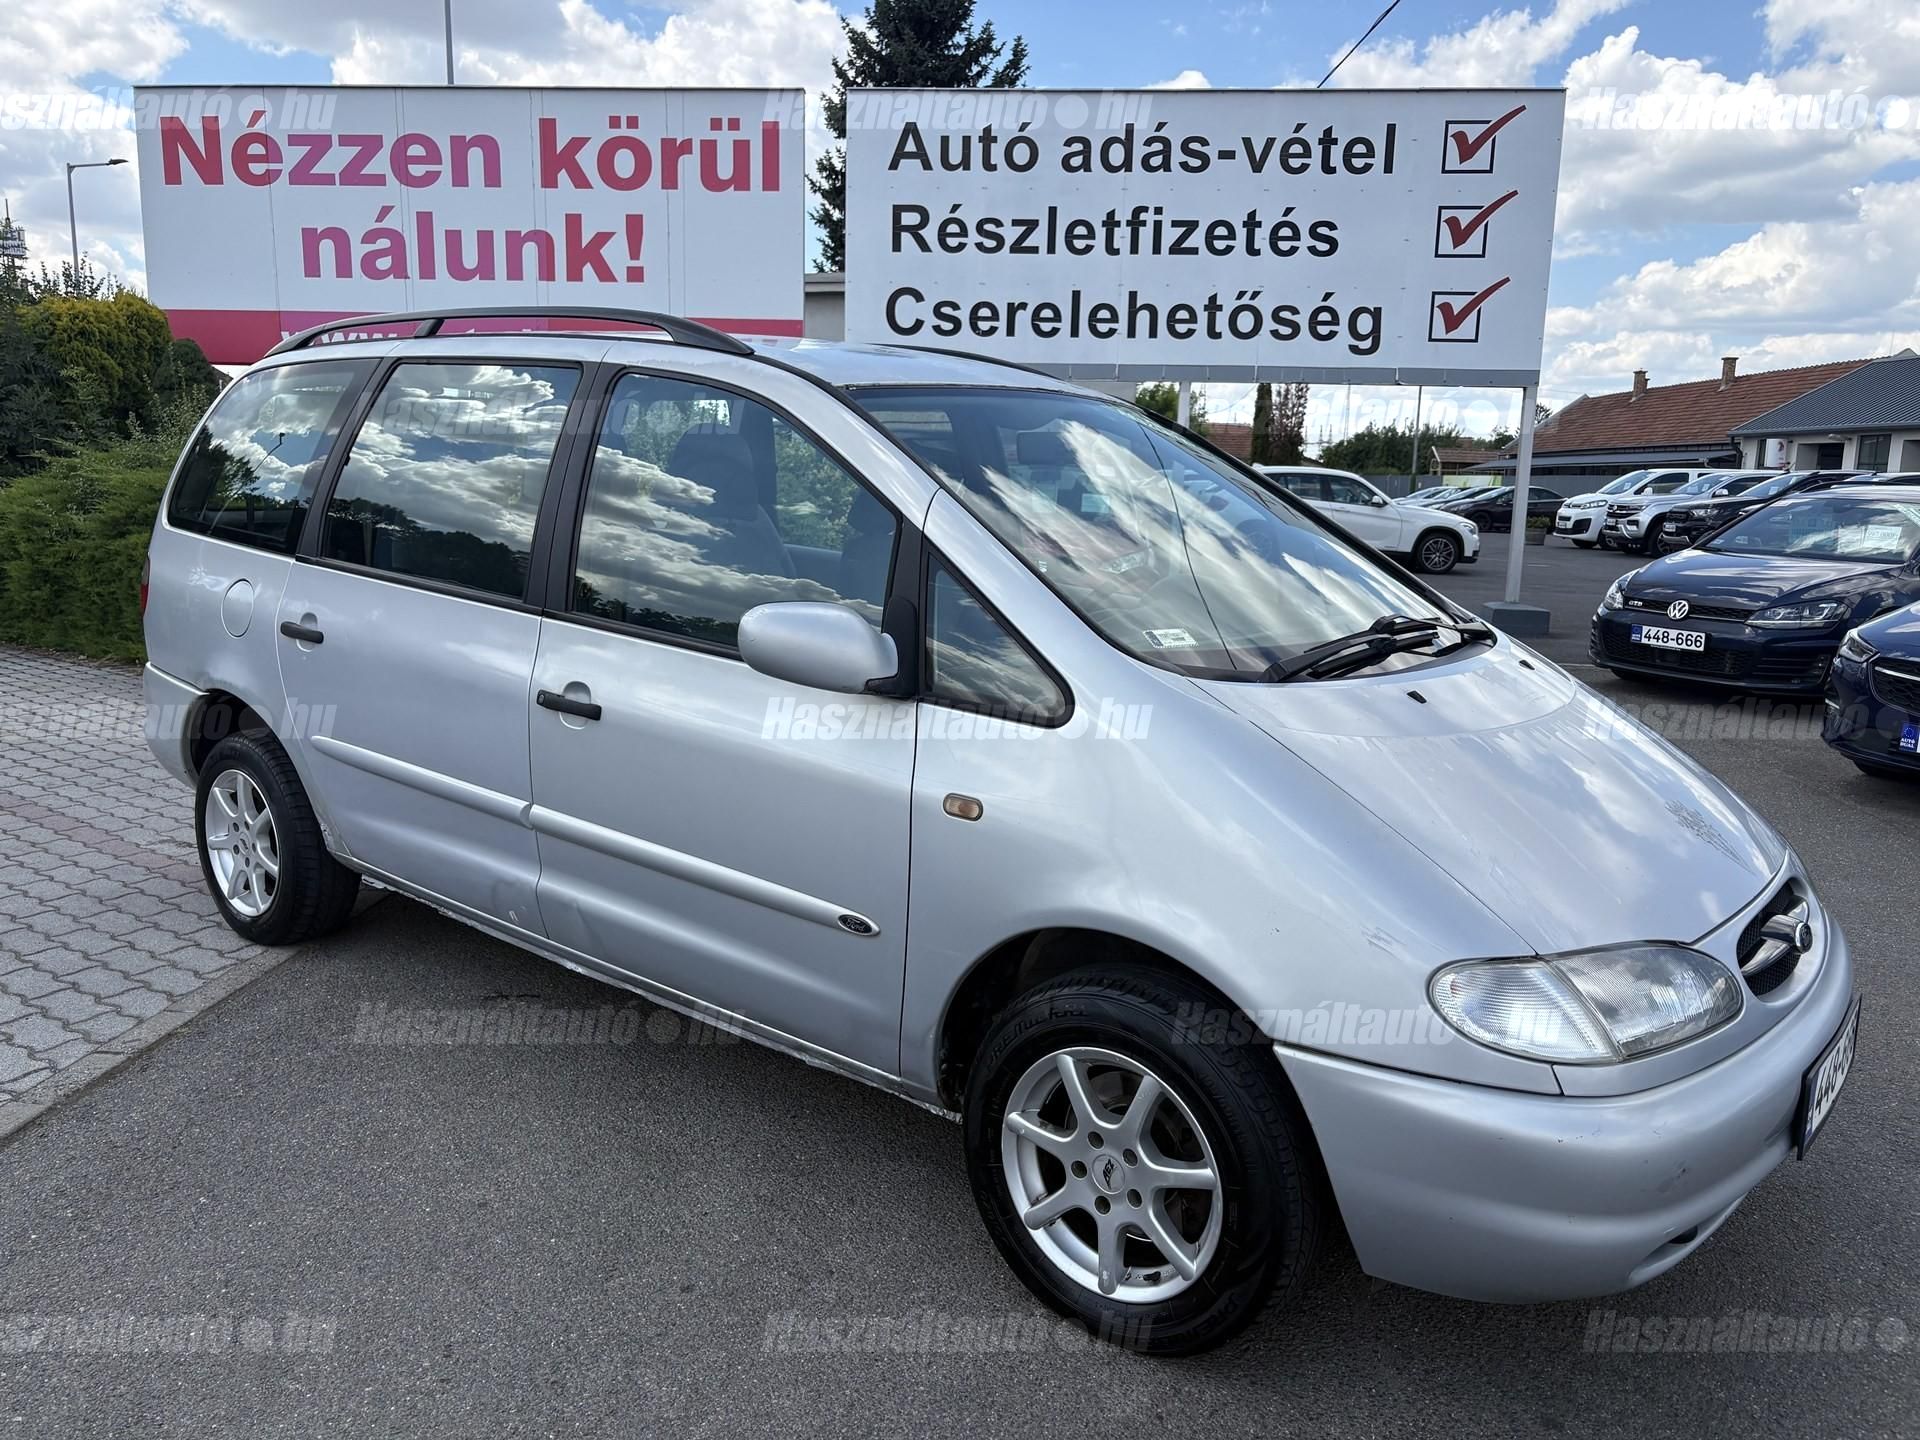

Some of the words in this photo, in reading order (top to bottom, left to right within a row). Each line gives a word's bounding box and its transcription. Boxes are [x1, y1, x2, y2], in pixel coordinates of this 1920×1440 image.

[160, 110, 501, 187] Nézzen
[539, 115, 781, 192] körül
[888, 121, 1040, 174] Autó
[1061, 121, 1397, 175] adás-vétel
[301, 205, 645, 283] nálunk!
[891, 203, 1339, 258] Részletfizetés
[886, 287, 1382, 357] Cserelehetőség
[1643, 628, 1704, 649] 448-666
